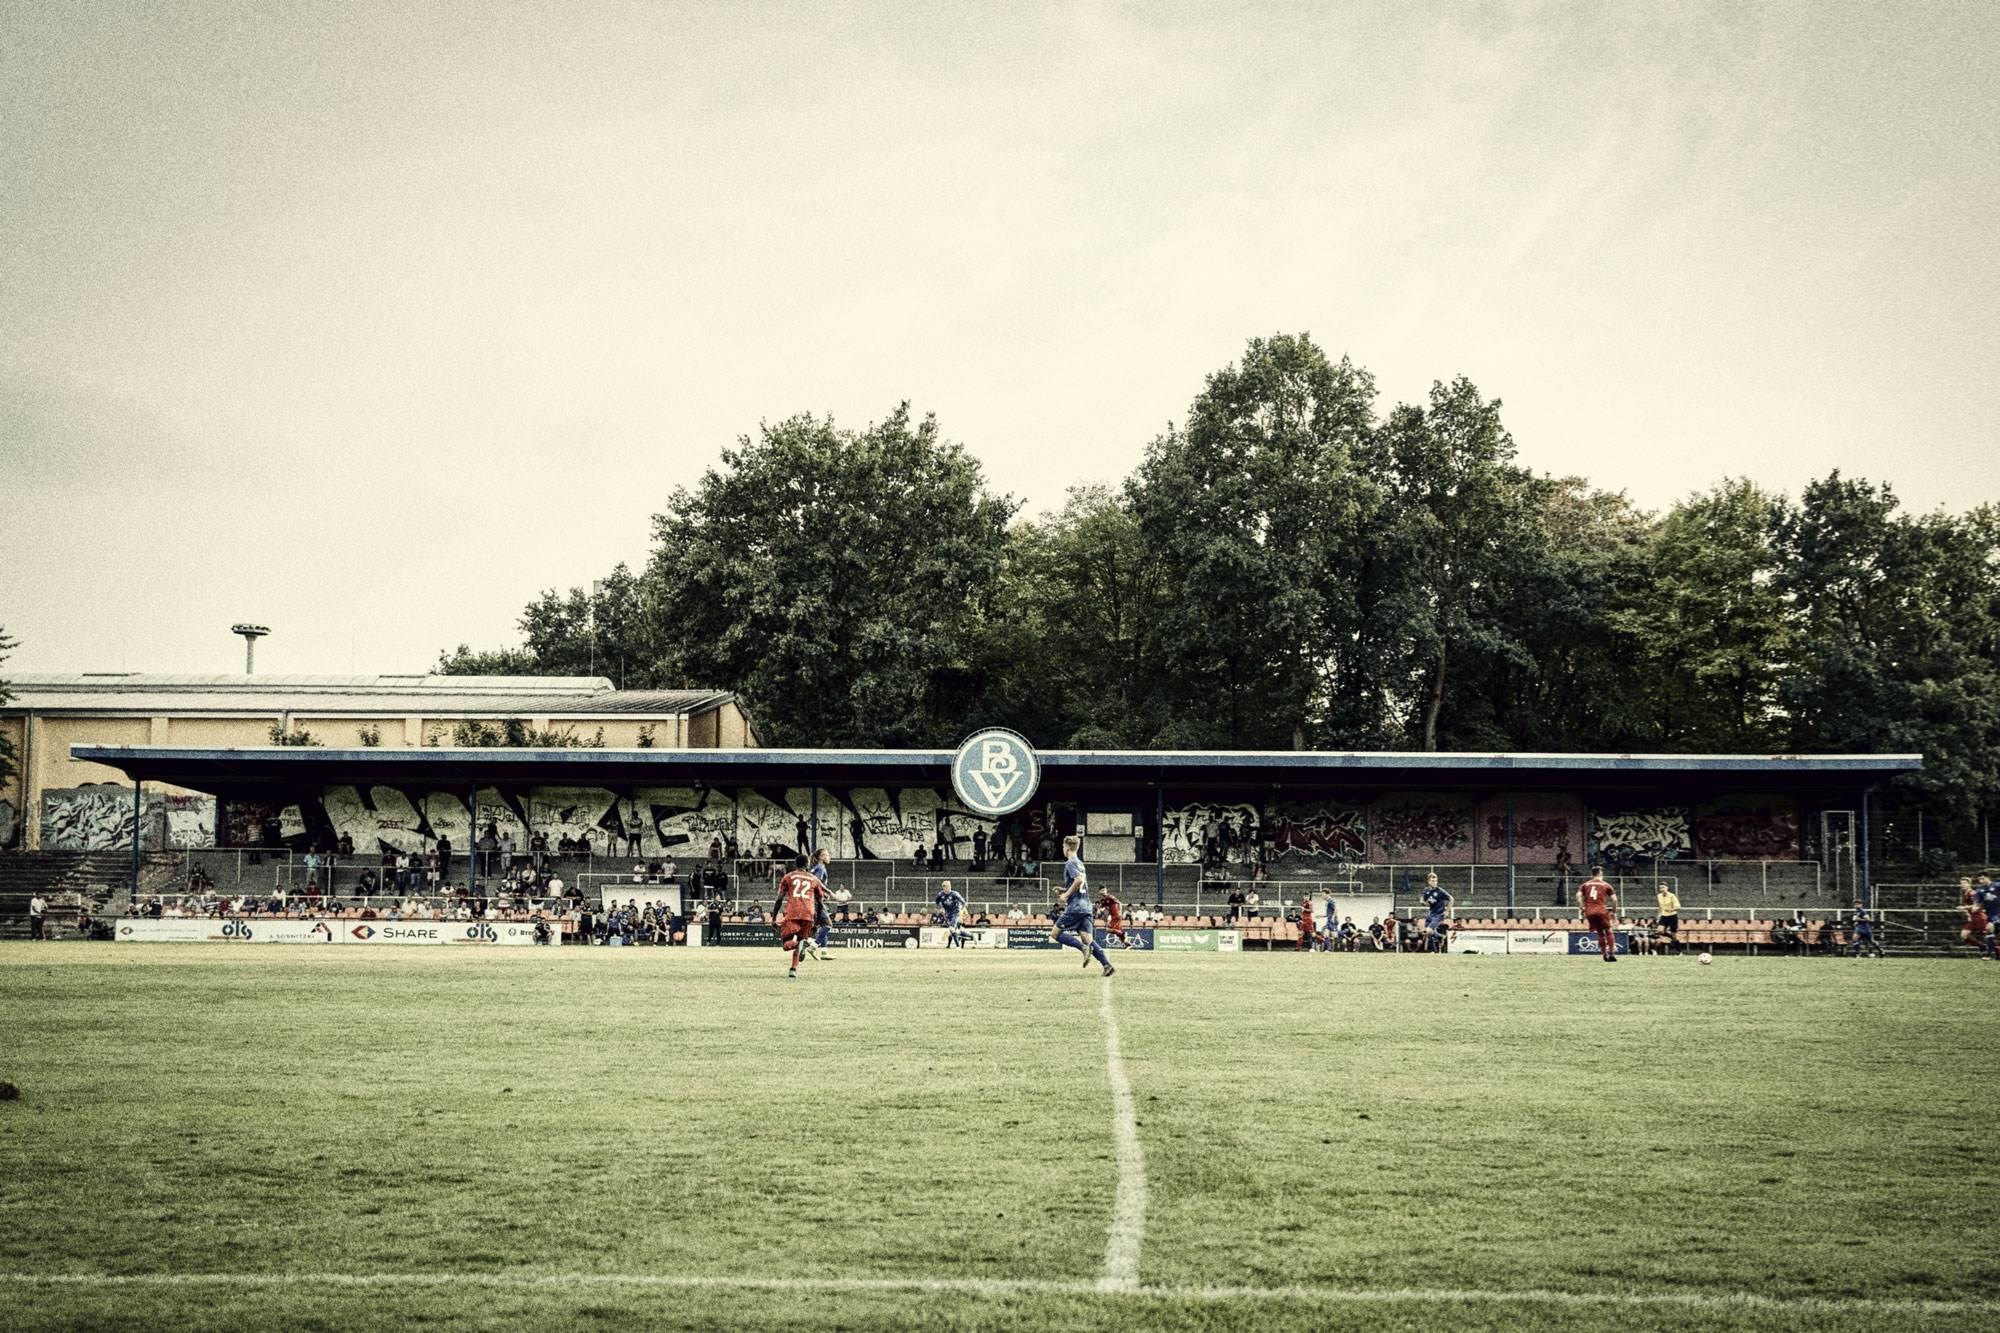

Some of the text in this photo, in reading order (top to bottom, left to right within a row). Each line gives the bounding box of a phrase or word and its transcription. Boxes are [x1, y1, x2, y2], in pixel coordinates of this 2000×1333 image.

[793, 879, 811, 899] 22
[1590, 886, 1598, 900] 4
[383, 927, 439, 939] SHARE
[847, 938, 884, 949] UNION
